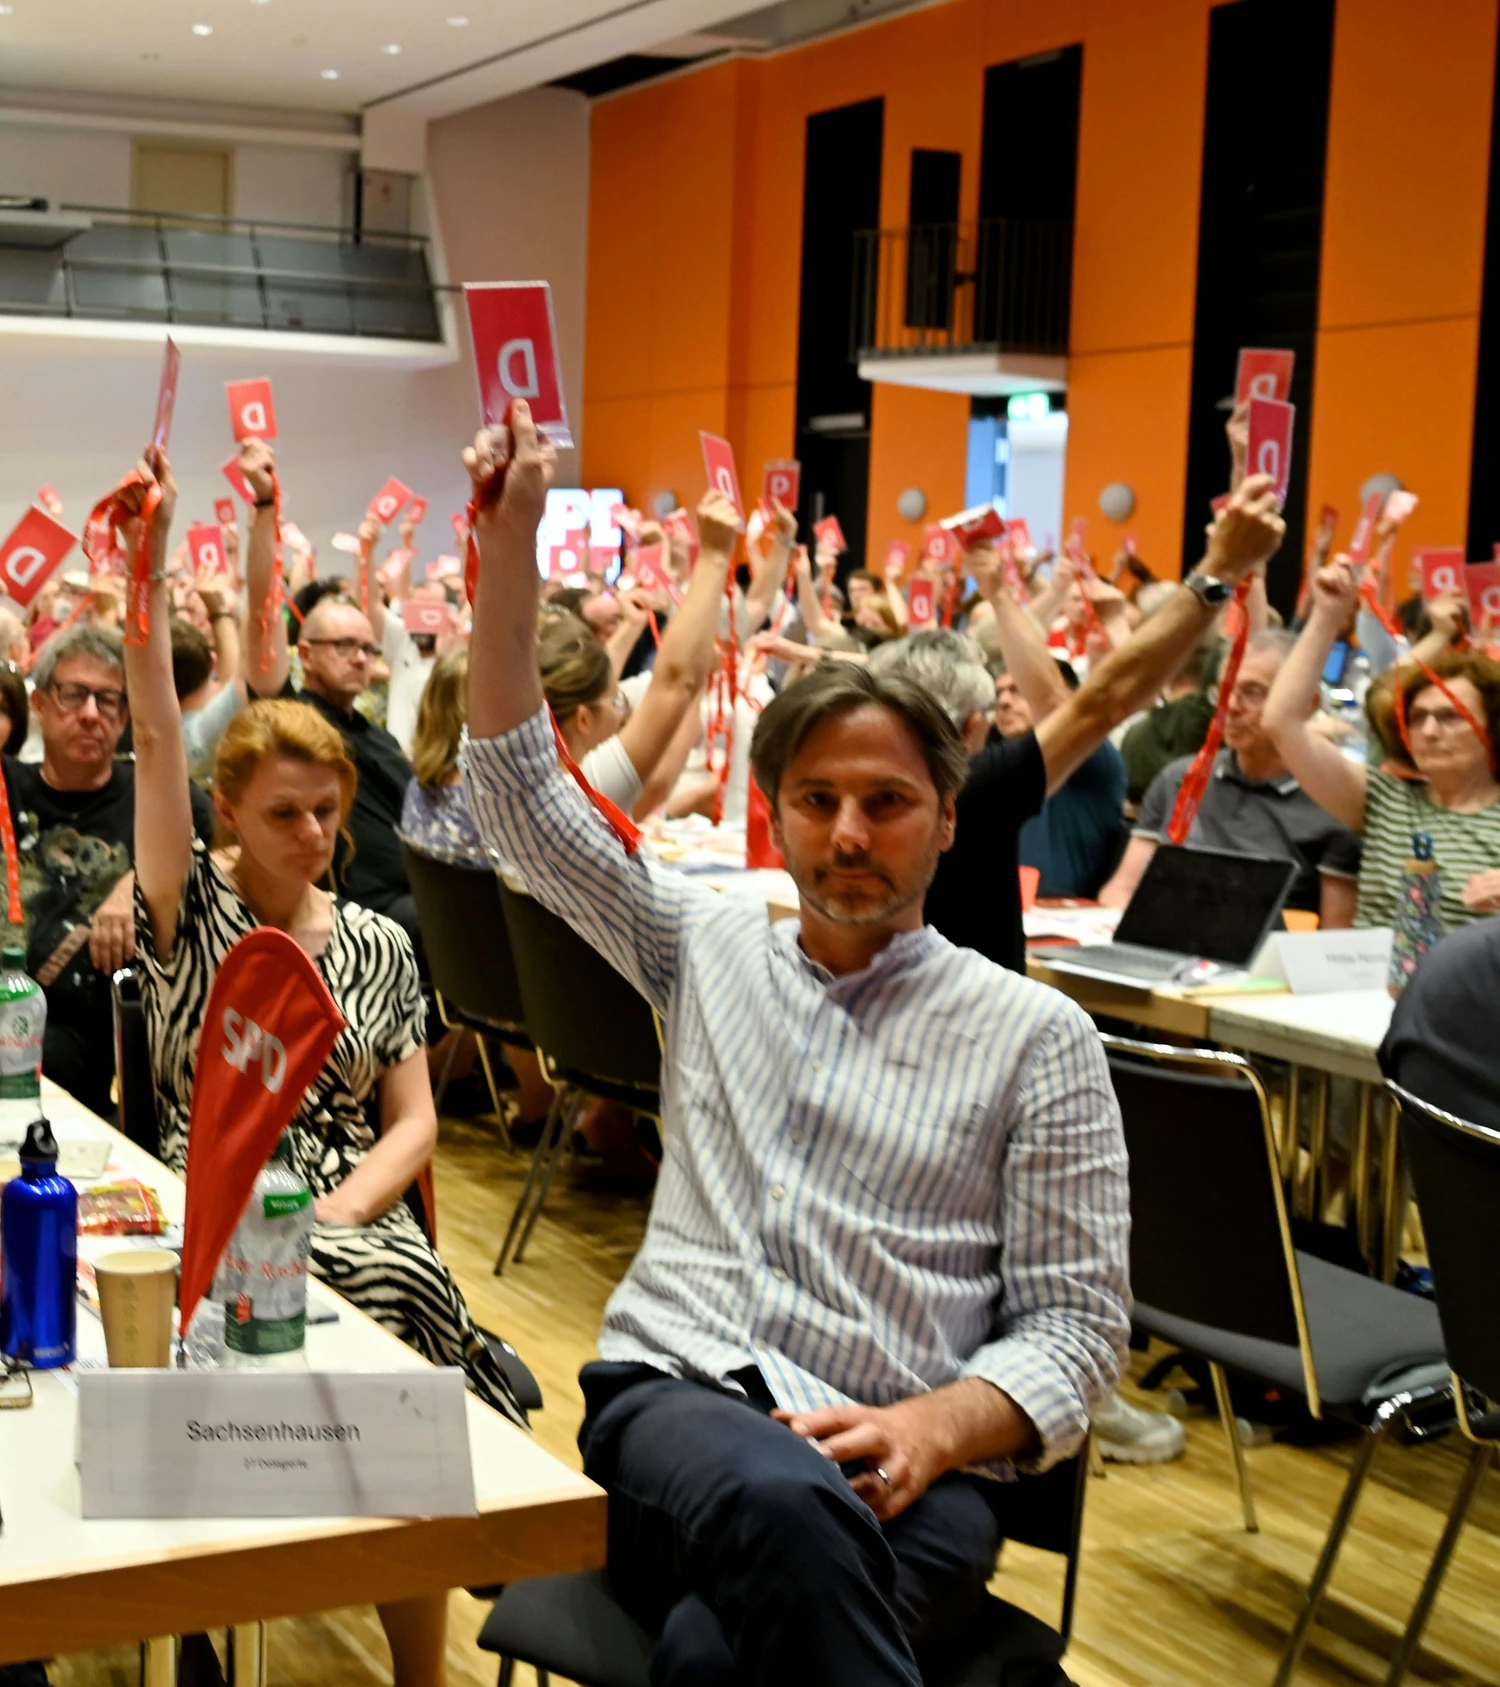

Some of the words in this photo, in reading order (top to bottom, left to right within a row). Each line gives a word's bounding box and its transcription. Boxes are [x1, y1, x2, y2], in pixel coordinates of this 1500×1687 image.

[498, 338, 540, 398] D
[242, 402, 266, 430] D
[1257, 440, 1279, 479] D
[6, 546, 46, 587] D
[199, 542, 219, 566] D
[1431, 566, 1457, 591] D
[221, 1007, 287, 1094] SPD
[186, 1419, 361, 1442] Sachsenhausen
